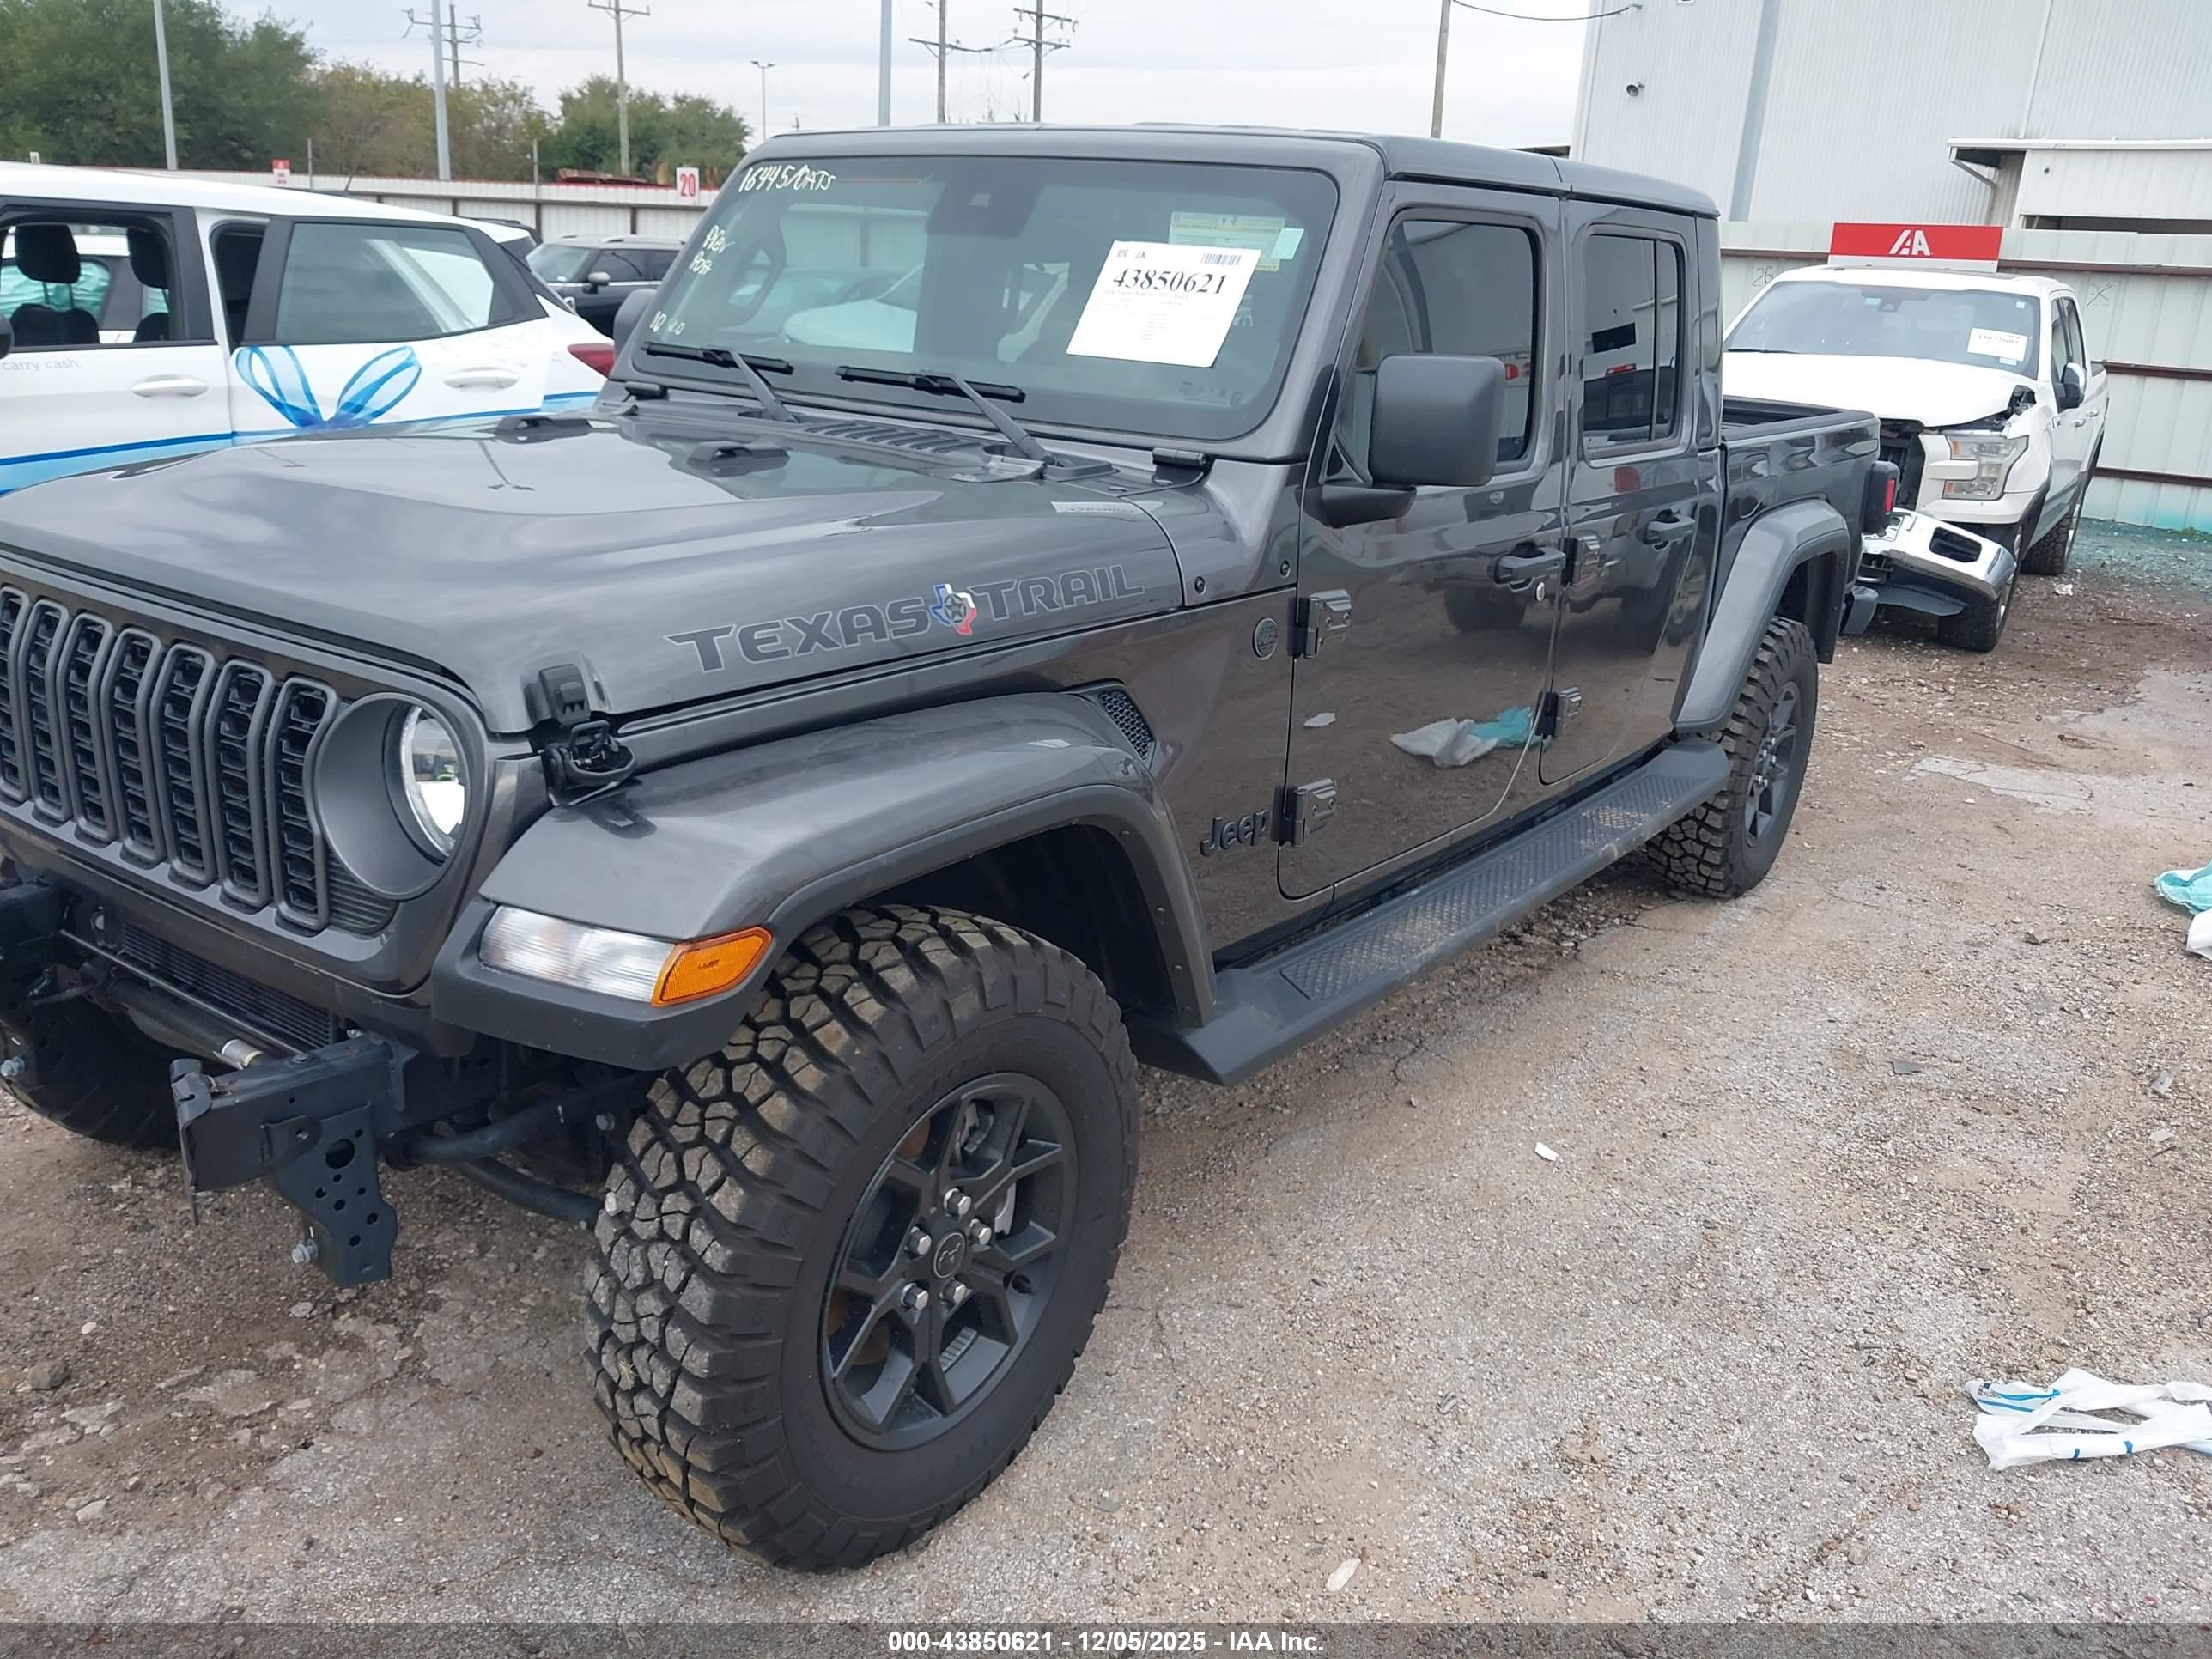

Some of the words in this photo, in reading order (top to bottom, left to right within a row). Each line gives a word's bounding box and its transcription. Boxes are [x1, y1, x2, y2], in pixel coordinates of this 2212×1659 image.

[680, 173, 696, 198] 20
[1112, 267, 1228, 295] 43850621
[1, 360, 40, 372] carry
[44, 357, 83, 369] cash.
[663, 595, 932, 674] TEXAS
[967, 563, 1146, 620] TRAIL
[1199, 808, 1272, 857] Jeep
